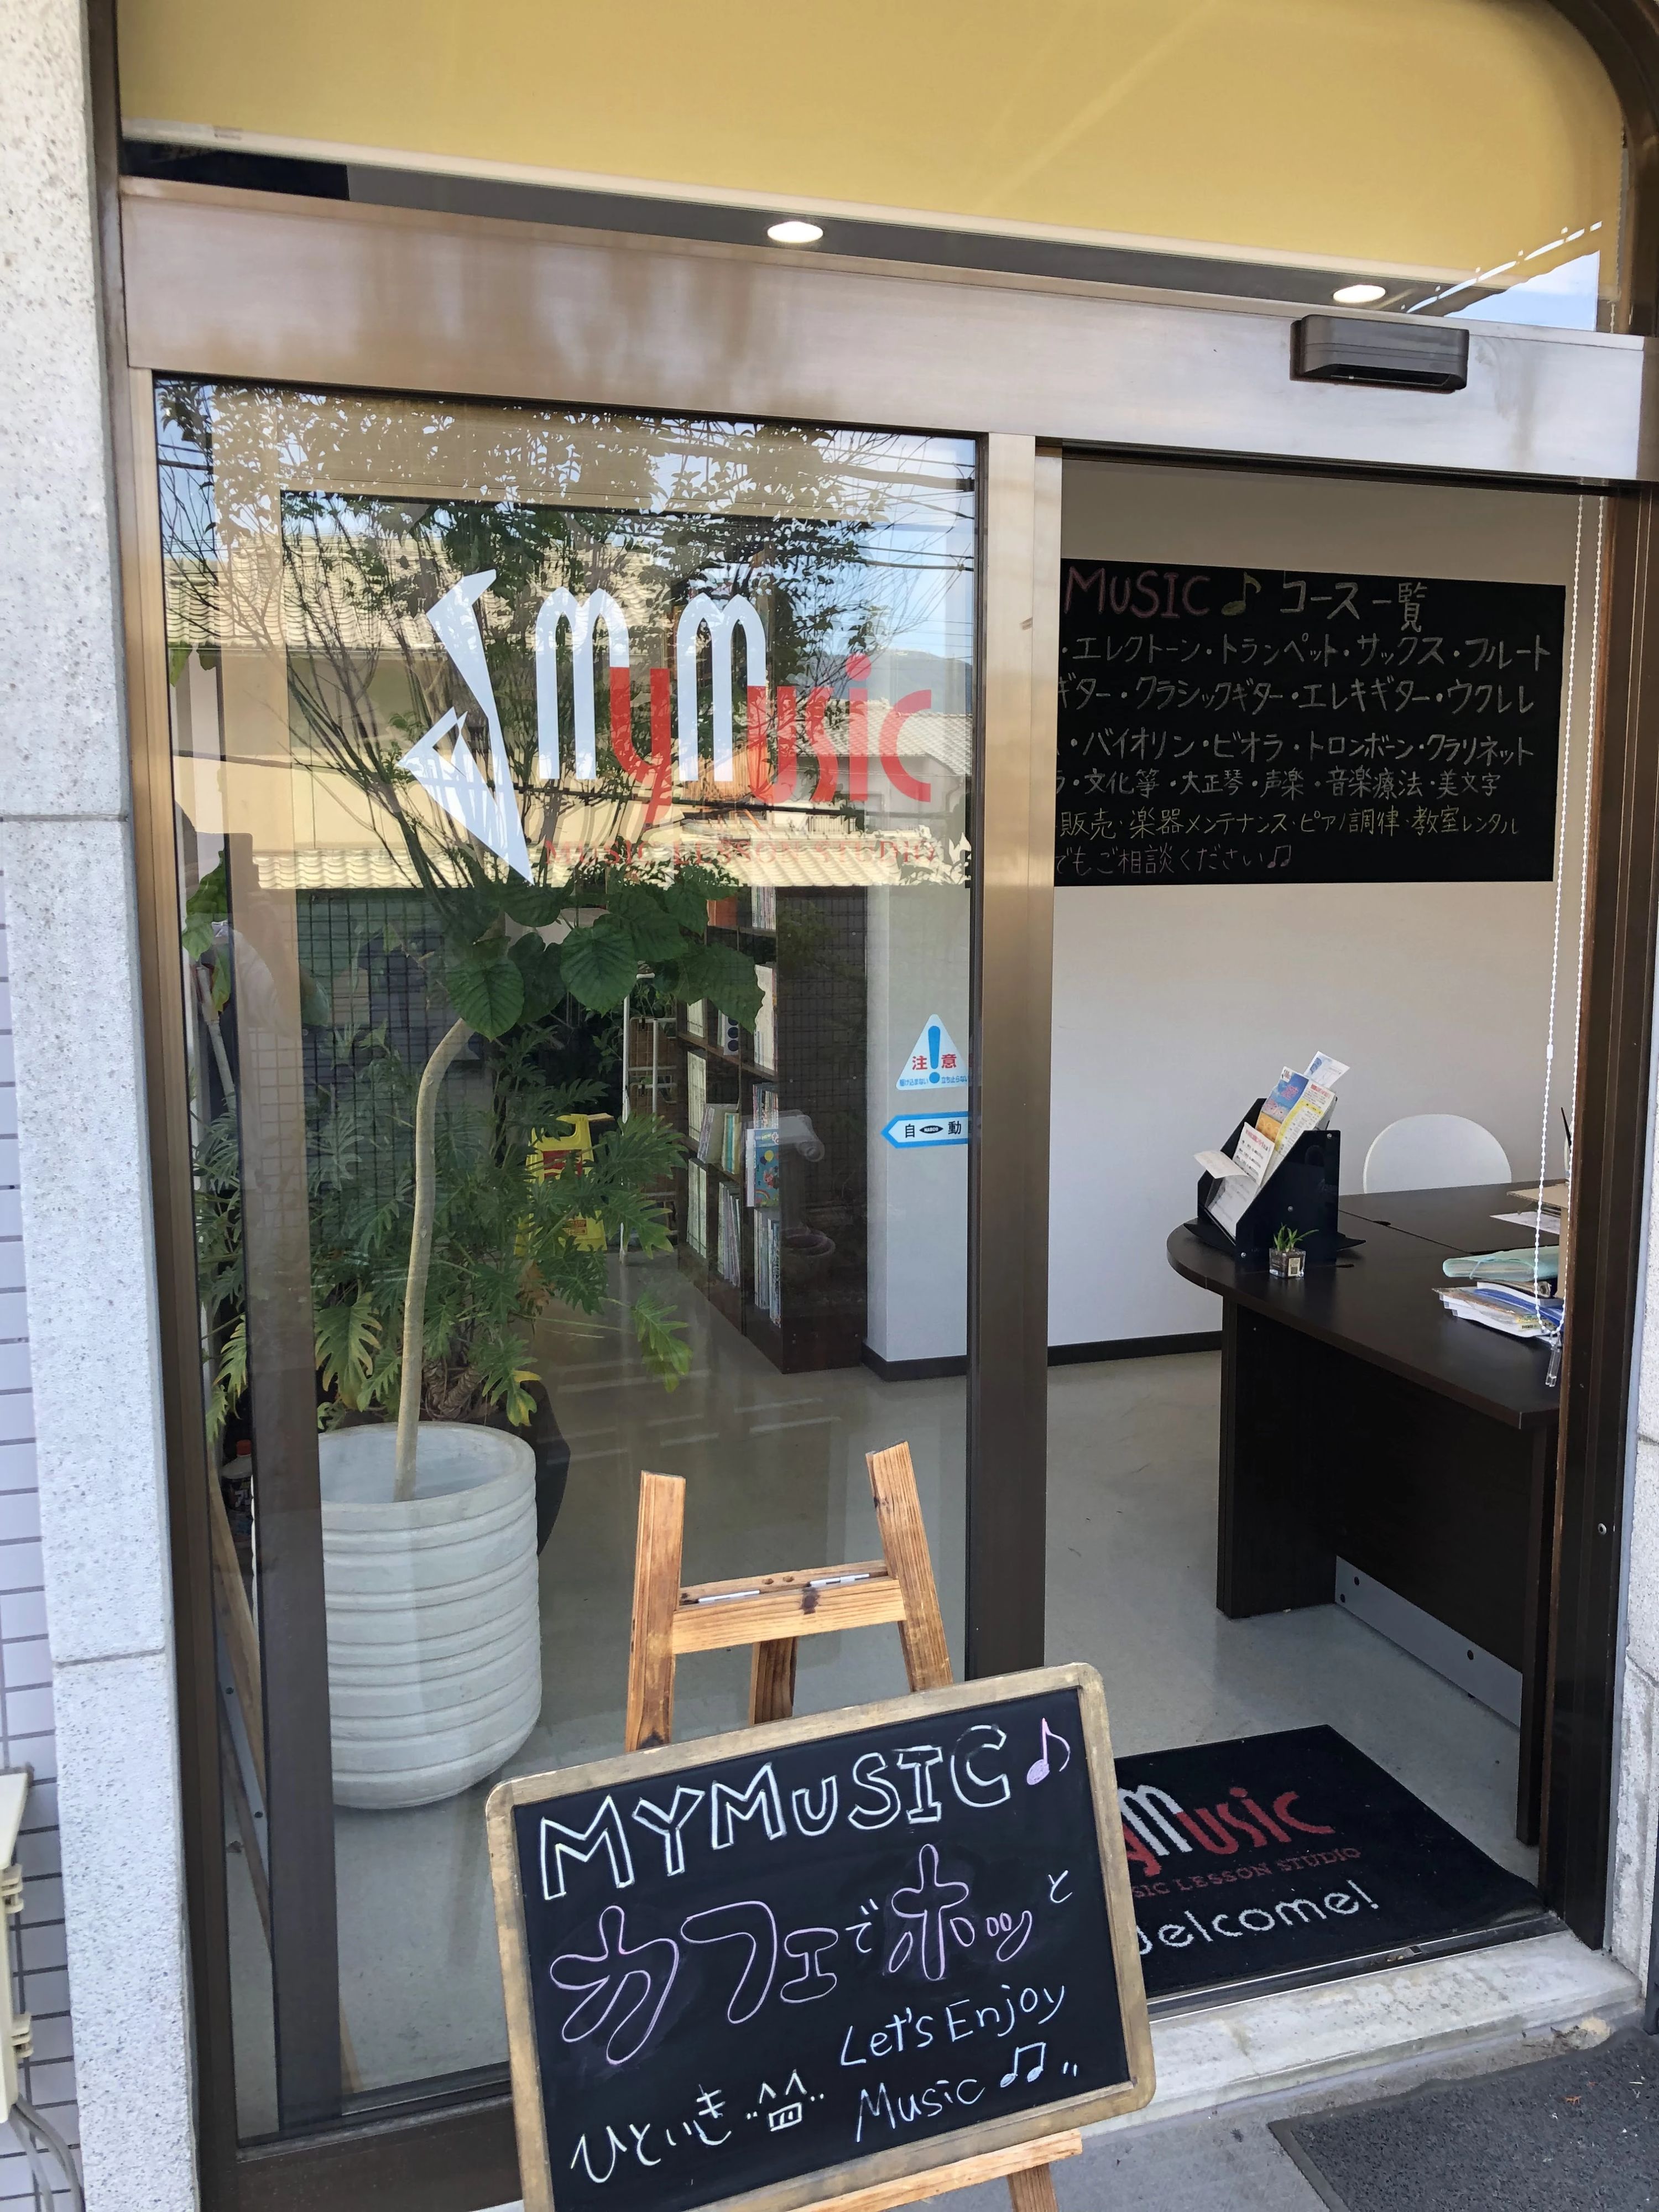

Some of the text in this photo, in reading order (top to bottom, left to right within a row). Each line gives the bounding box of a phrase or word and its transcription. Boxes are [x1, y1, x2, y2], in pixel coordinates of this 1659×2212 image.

[1280, 580, 1428, 633] コース一覧
[544, 839, 655, 865] MUSIC
[816, 839, 936, 863] STUDIO
[1172, 1862, 1272, 1893] LESSON
[1276, 1846, 1361, 1872] STUDIO
[840, 1984, 1066, 2066] Let's Enjoy
[570, 2083, 733, 2184] ひといき
[855, 2078, 986, 2143] Music
